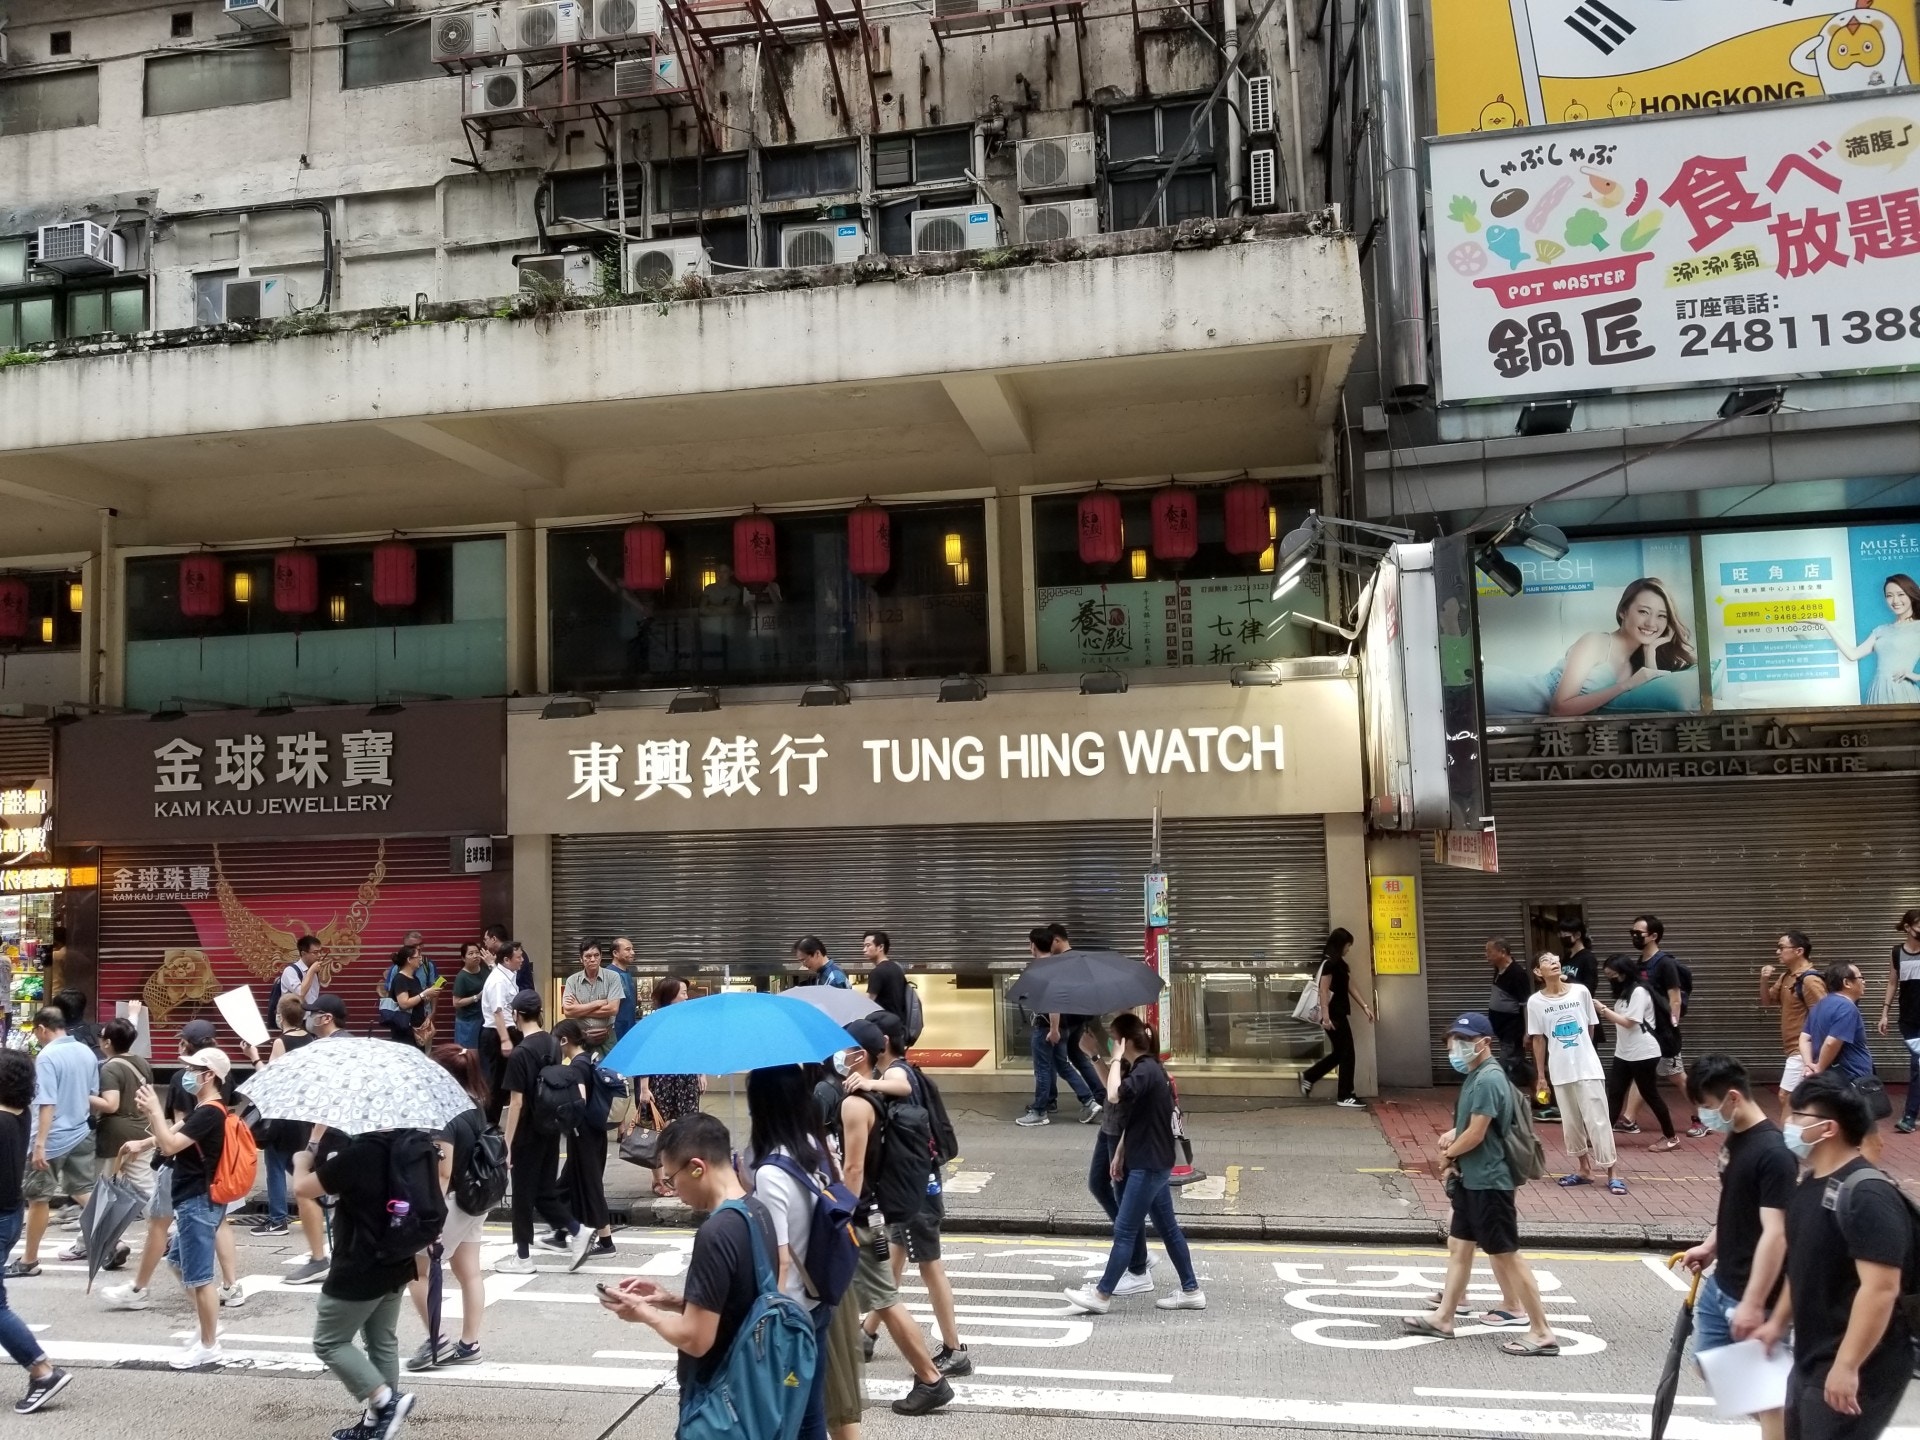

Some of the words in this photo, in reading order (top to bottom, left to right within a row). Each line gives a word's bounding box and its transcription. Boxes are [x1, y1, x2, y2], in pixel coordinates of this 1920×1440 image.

[1640, 80, 1805, 116] HONGKONG
[1845, 129, 1895, 158] 満腹
[1479, 144, 1618, 188] しゃぶしゃぶ
[1673, 249, 1760, 284] 涮涮鍋
[1508, 283, 1543, 301] POT
[1552, 269, 1626, 292] MASTER
[1488, 297, 1657, 379] 鍋匠
[1732, 563, 1820, 581] 旺角店
[1568, 583, 1587, 591] SALON
[1540, 717, 1800, 757] 飛達商業中心
[153, 729, 394, 792] 金球珠寶
[566, 732, 829, 803] 東興錶行
[862, 736, 985, 783] TUNG
[999, 730, 1105, 779] HING
[1119, 724, 1284, 774] WATCH
[1536, 764, 1576, 780] TAT
[1590, 757, 1758, 778] COMMERCIAL
[1773, 755, 1869, 774] CENTRE
[154, 801, 201, 818] KAM
[206, 799, 252, 816] KAU
[256, 794, 392, 815] JEWELLERY
[465, 846, 492, 864] 金球珠寶
[112, 866, 211, 892] 金球珠寶
[1385, 880, 1400, 892] 租
[113, 893, 131, 901] KAM
[133, 893, 153, 901] KAU
[155, 891, 210, 901] JEWELLERY
[1559, 1001, 1581, 1011] BUMP
